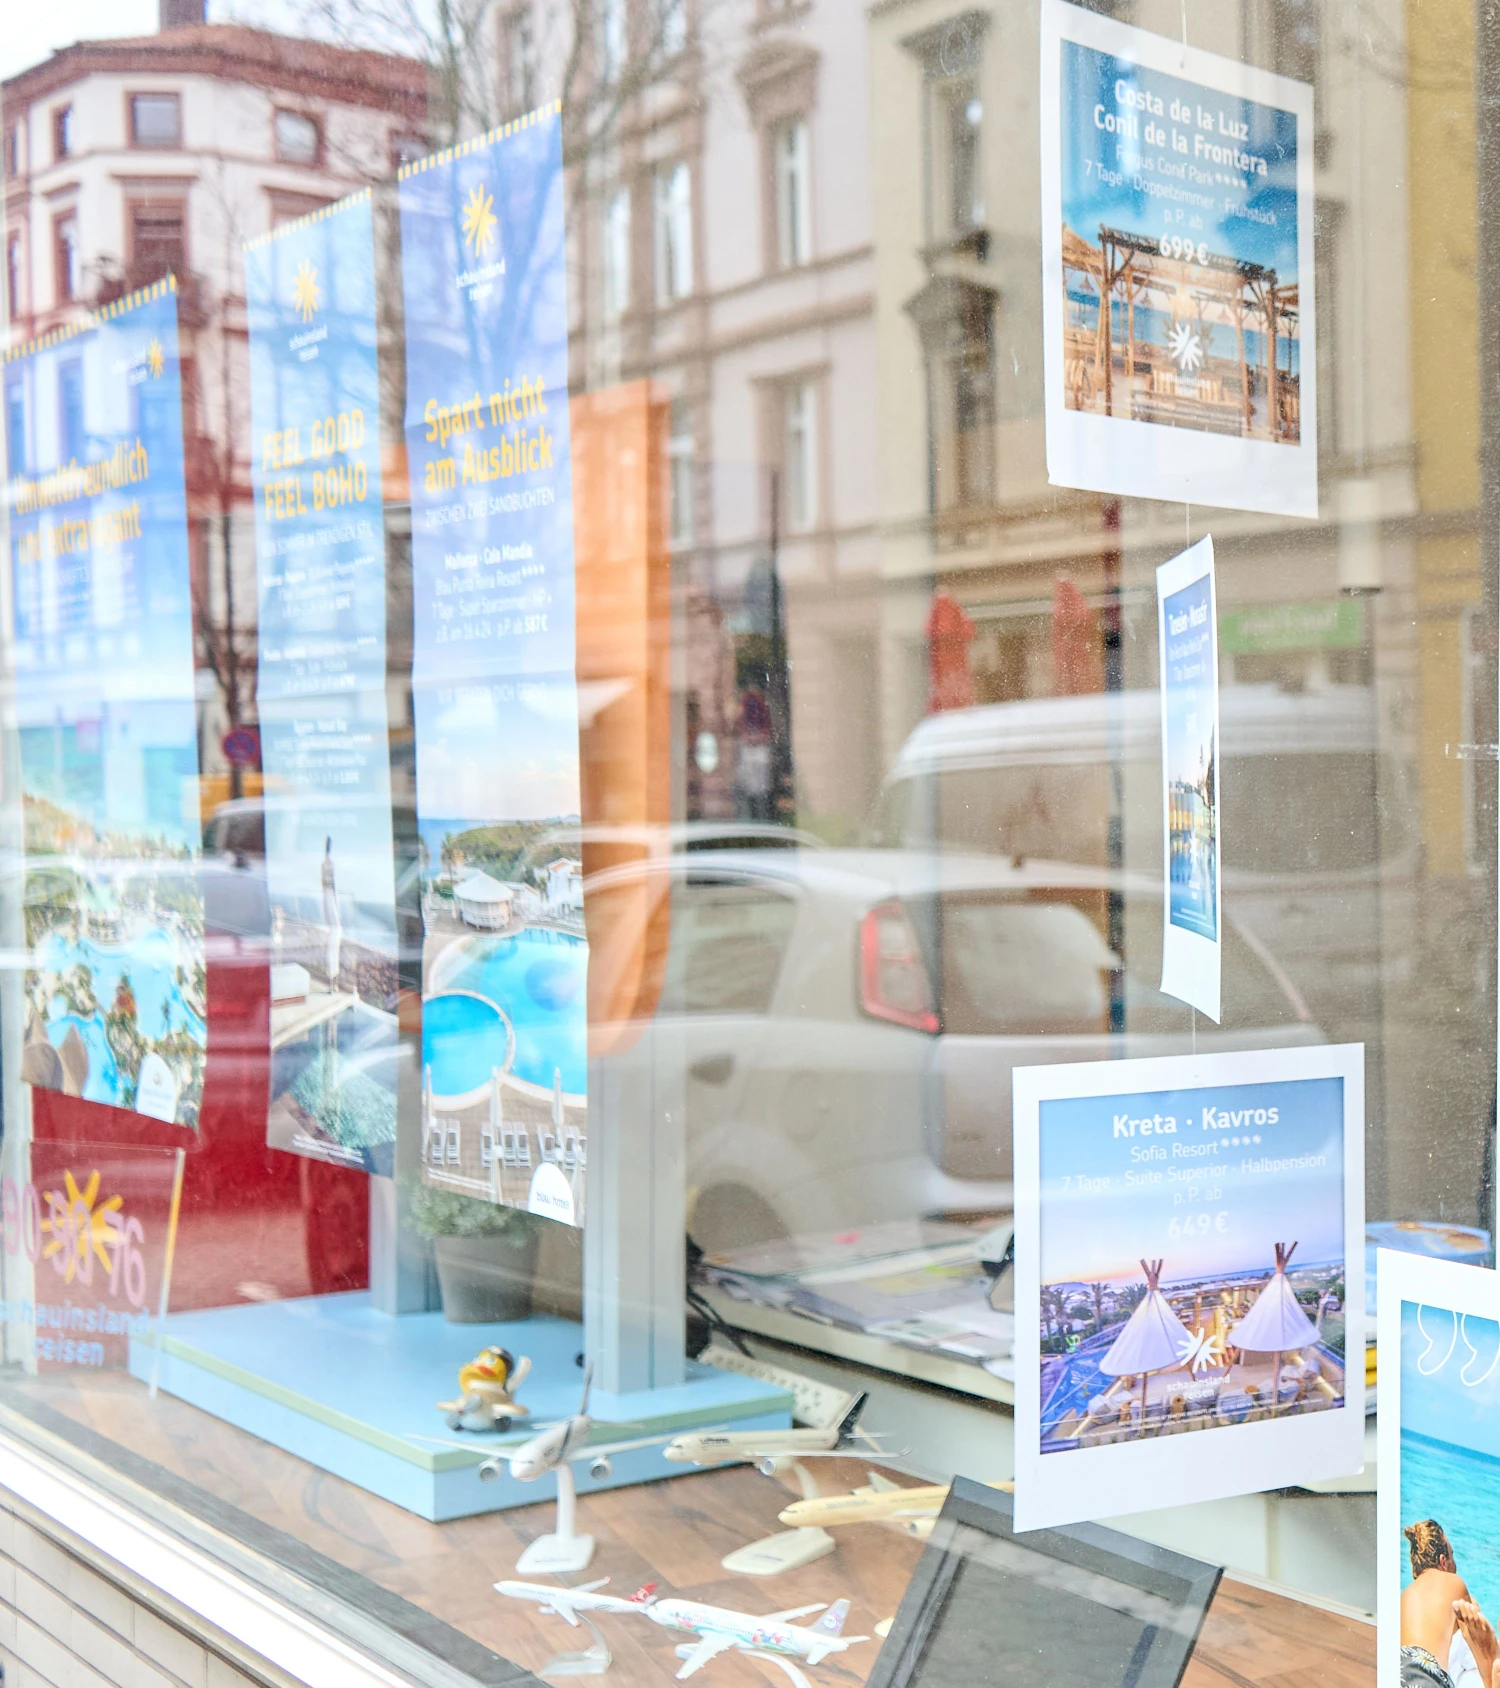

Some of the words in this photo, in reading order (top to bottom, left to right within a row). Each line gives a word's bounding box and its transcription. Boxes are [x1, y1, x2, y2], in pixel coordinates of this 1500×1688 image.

[1115, 79, 1164, 116] Costa
[1169, 98, 1191, 125] de
[1197, 105, 1213, 131] la
[1219, 111, 1249, 141] Luz
[1093, 104, 1138, 140] Conil
[1144, 122, 1166, 147] de
[1172, 128, 1188, 154] la
[1194, 134, 1268, 176] Frontera
[1084, 159, 1093, 176] 7
[1096, 163, 1123, 187] Tage
[1133, 174, 1215, 209] Doppelzimmer
[1188, 166, 1214, 187] Park
[1189, 213, 1203, 230] ab
[424, 391, 485, 449] Spart
[489, 373, 548, 426] nicht
[262, 428, 304, 473] FEEL
[312, 408, 365, 459] GOOD
[425, 457, 456, 494] am
[462, 424, 553, 485] Ausblick
[264, 477, 308, 522] FEEL
[313, 461, 367, 511] BOHO
[1113, 1113, 1177, 1139] Kreta
[1202, 1106, 1279, 1131] Kavros
[1131, 1143, 1167, 1163] Sofia
[1172, 1140, 1219, 1158] Resort
[1061, 1176, 1071, 1193] 7
[1076, 1174, 1110, 1193] Tage
[1125, 1166, 1162, 1186] Suite
[1167, 1162, 1228, 1184] Superior
[1241, 1153, 1326, 1175] Halbpension
[1205, 1185, 1223, 1201] ab
[34, 1330, 104, 1367] reisen
[1166, 1374, 1231, 1392] schauinsland
